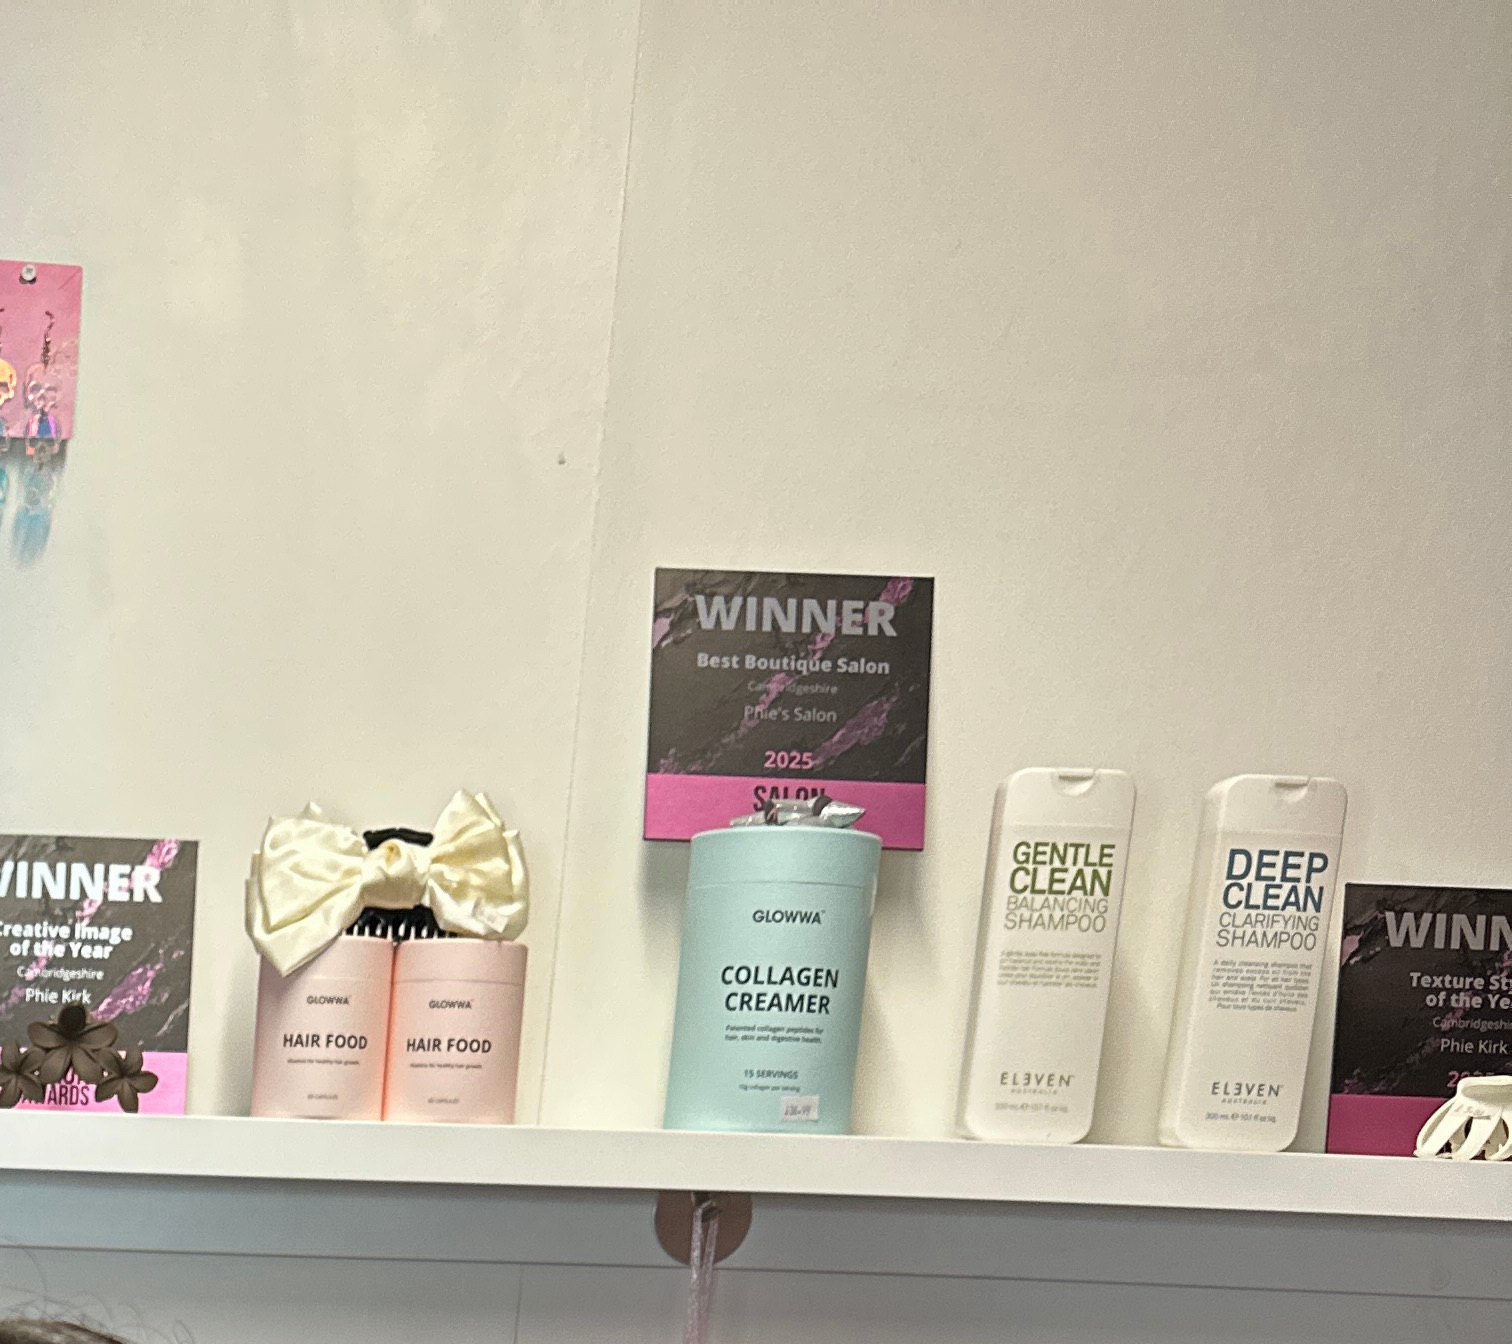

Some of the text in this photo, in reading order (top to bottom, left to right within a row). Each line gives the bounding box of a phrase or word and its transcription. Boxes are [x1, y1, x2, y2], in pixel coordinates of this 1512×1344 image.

[695, 594, 898, 637] WINNER
[697, 652, 890, 674] Best Boutique Salon
[744, 705, 837, 723] Phie's Salon
[763, 750, 814, 770] 2025
[1012, 841, 1116, 868] GENTLE
[1225, 848, 1329, 884] DEEP
[1009, 866, 1113, 897] CLEAN
[1006, 895, 1109, 914] BALANCING
[1222, 881, 1324, 913] CLEAN
[752, 909, 822, 924] GLOWWA
[1003, 911, 1106, 933] SHAMPOO
[1219, 911, 1320, 932] CLARIFYING
[75, 922, 133, 944] Image
[1215, 928, 1317, 951] SHAMPOO
[10, 940, 114, 959] of the Year
[721, 965, 839, 989] COLLAGEN
[1409, 972, 1485, 990] Texture
[25, 987, 92, 1004] Phie Kirk
[725, 992, 830, 1015] CREAMER
[1425, 991, 1447, 1008] of
[1450, 991, 1483, 1009] the
[283, 1034, 368, 1049] HAIR FOOD
[407, 1038, 492, 1053] HAIR FOOD
[1441, 1038, 1508, 1054] Phie Kirk
[1211, 1081, 1280, 1097] ELEVEN
